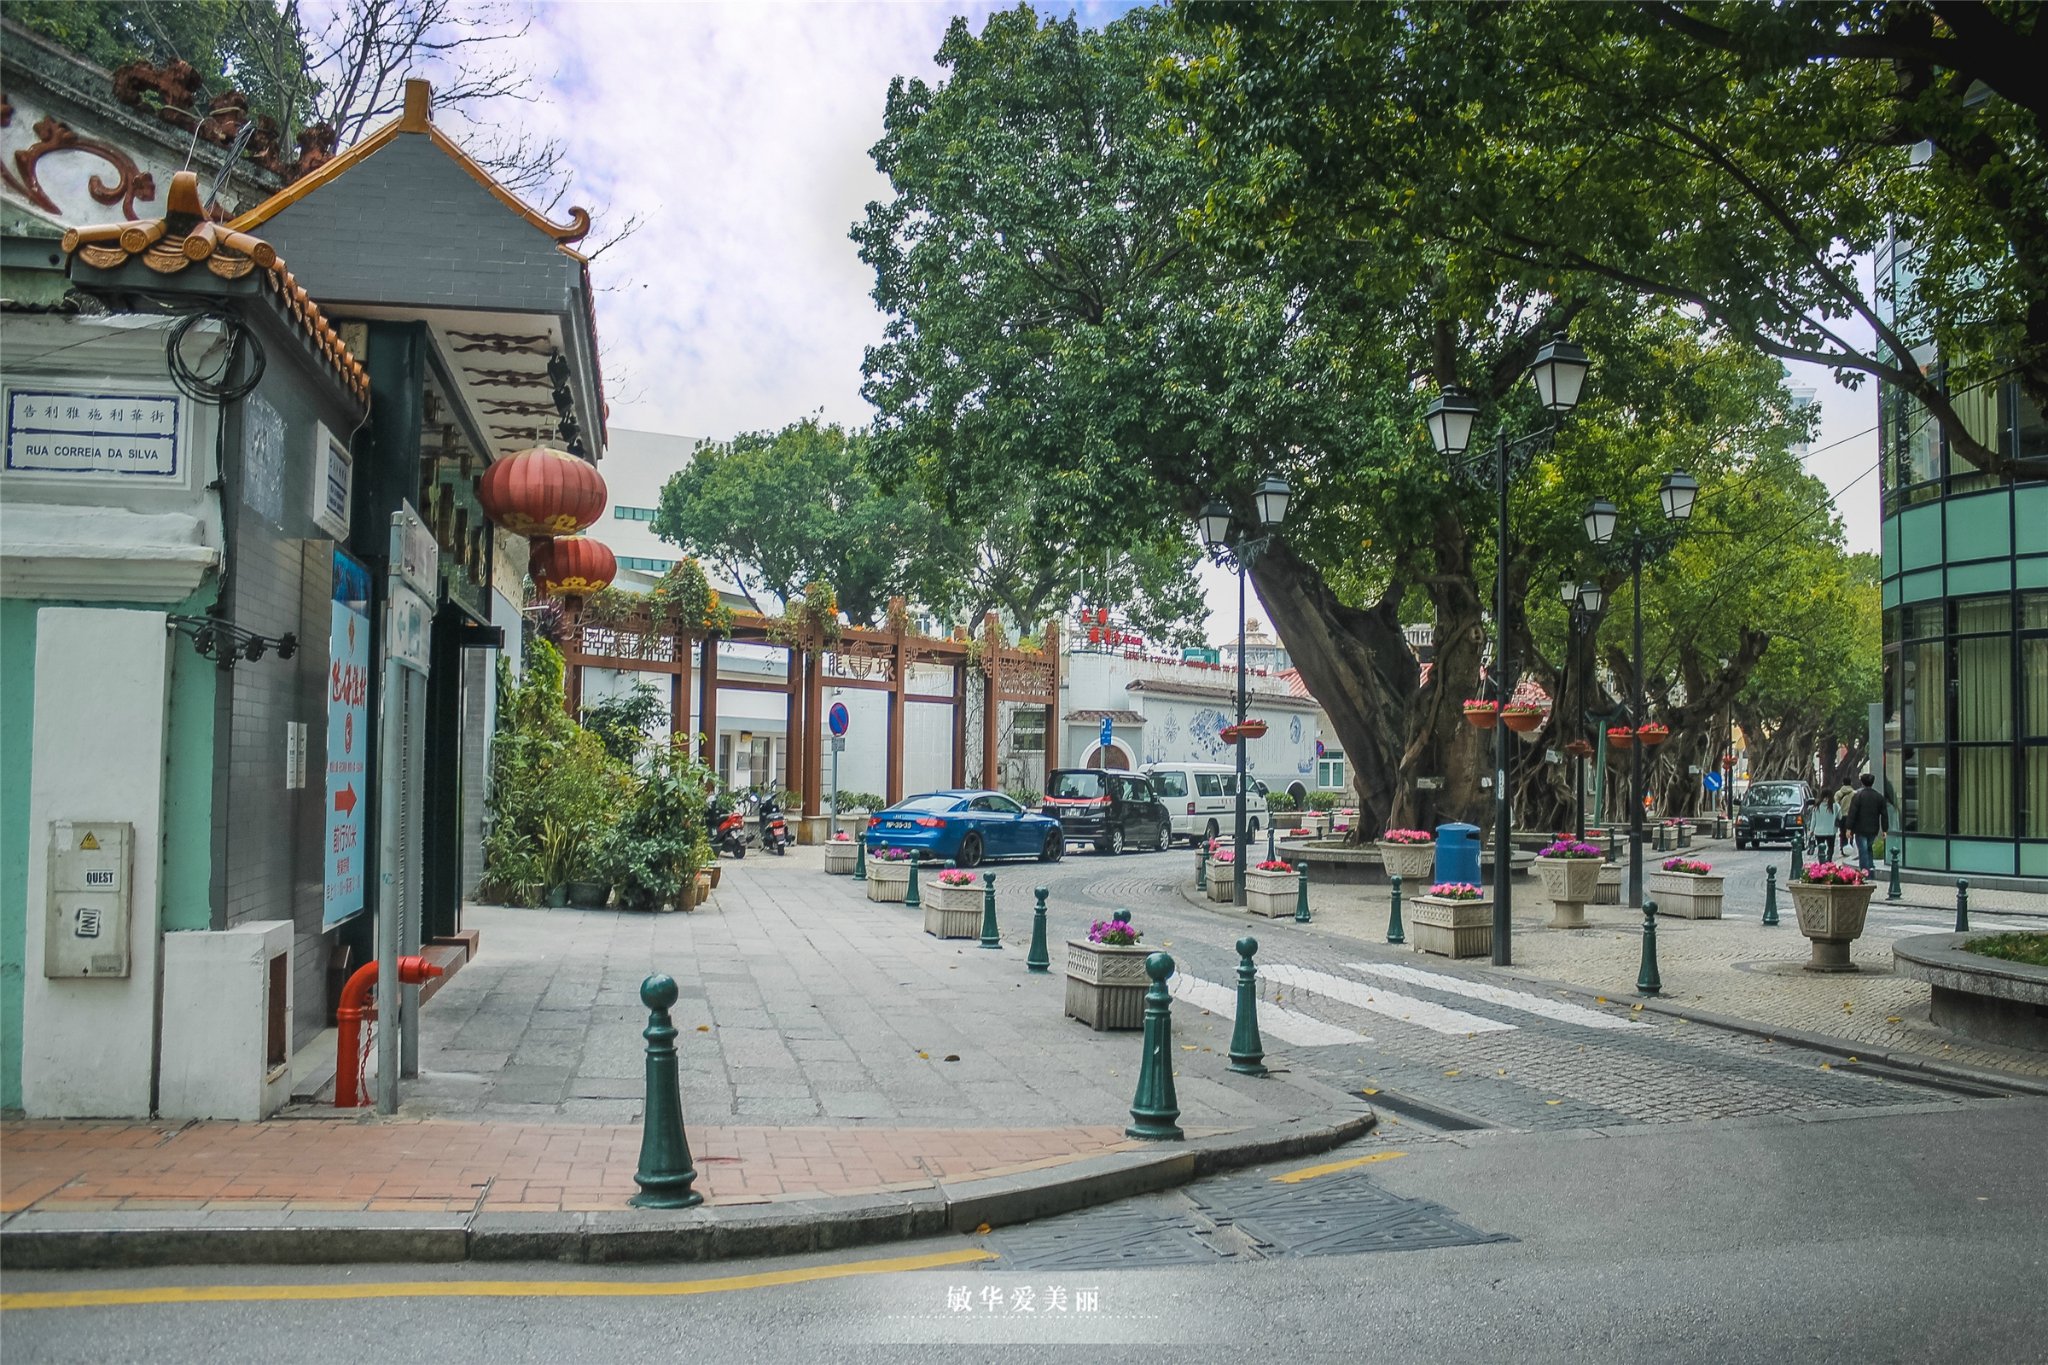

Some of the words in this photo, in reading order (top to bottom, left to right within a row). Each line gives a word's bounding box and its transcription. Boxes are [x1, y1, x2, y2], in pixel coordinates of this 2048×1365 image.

[23, 405, 165, 424] 告利雅施利華街
[26, 446, 49, 456] RUA
[54, 446, 102, 458] CORREIA
[108, 448, 123, 459] DA
[129, 449, 158, 460] SILVA
[86, 872, 113, 884] QUEST
